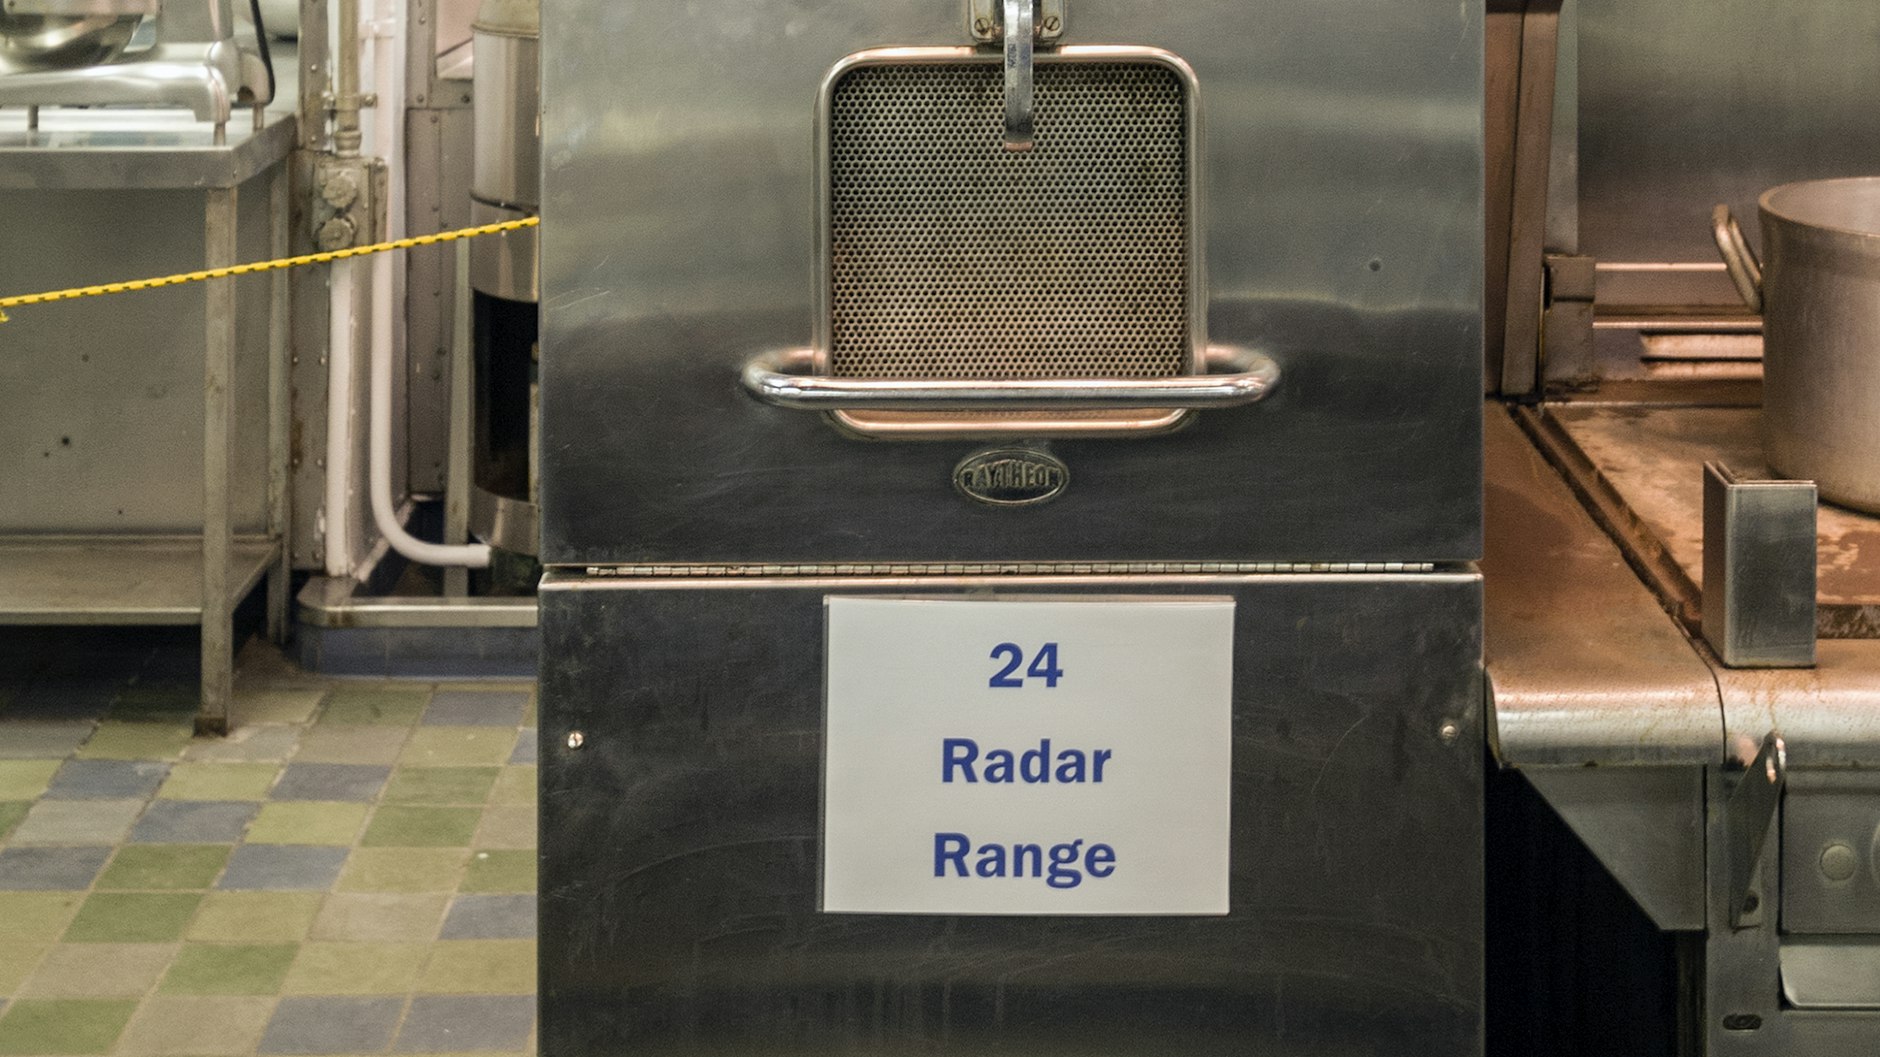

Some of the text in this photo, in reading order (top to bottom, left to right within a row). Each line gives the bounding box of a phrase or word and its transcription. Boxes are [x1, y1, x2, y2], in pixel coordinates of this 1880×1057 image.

[960, 459, 1062, 488] RAYTHEON
[988, 642, 1063, 688] 24
[941, 738, 1113, 784] Radar
[934, 832, 1117, 889] Range
